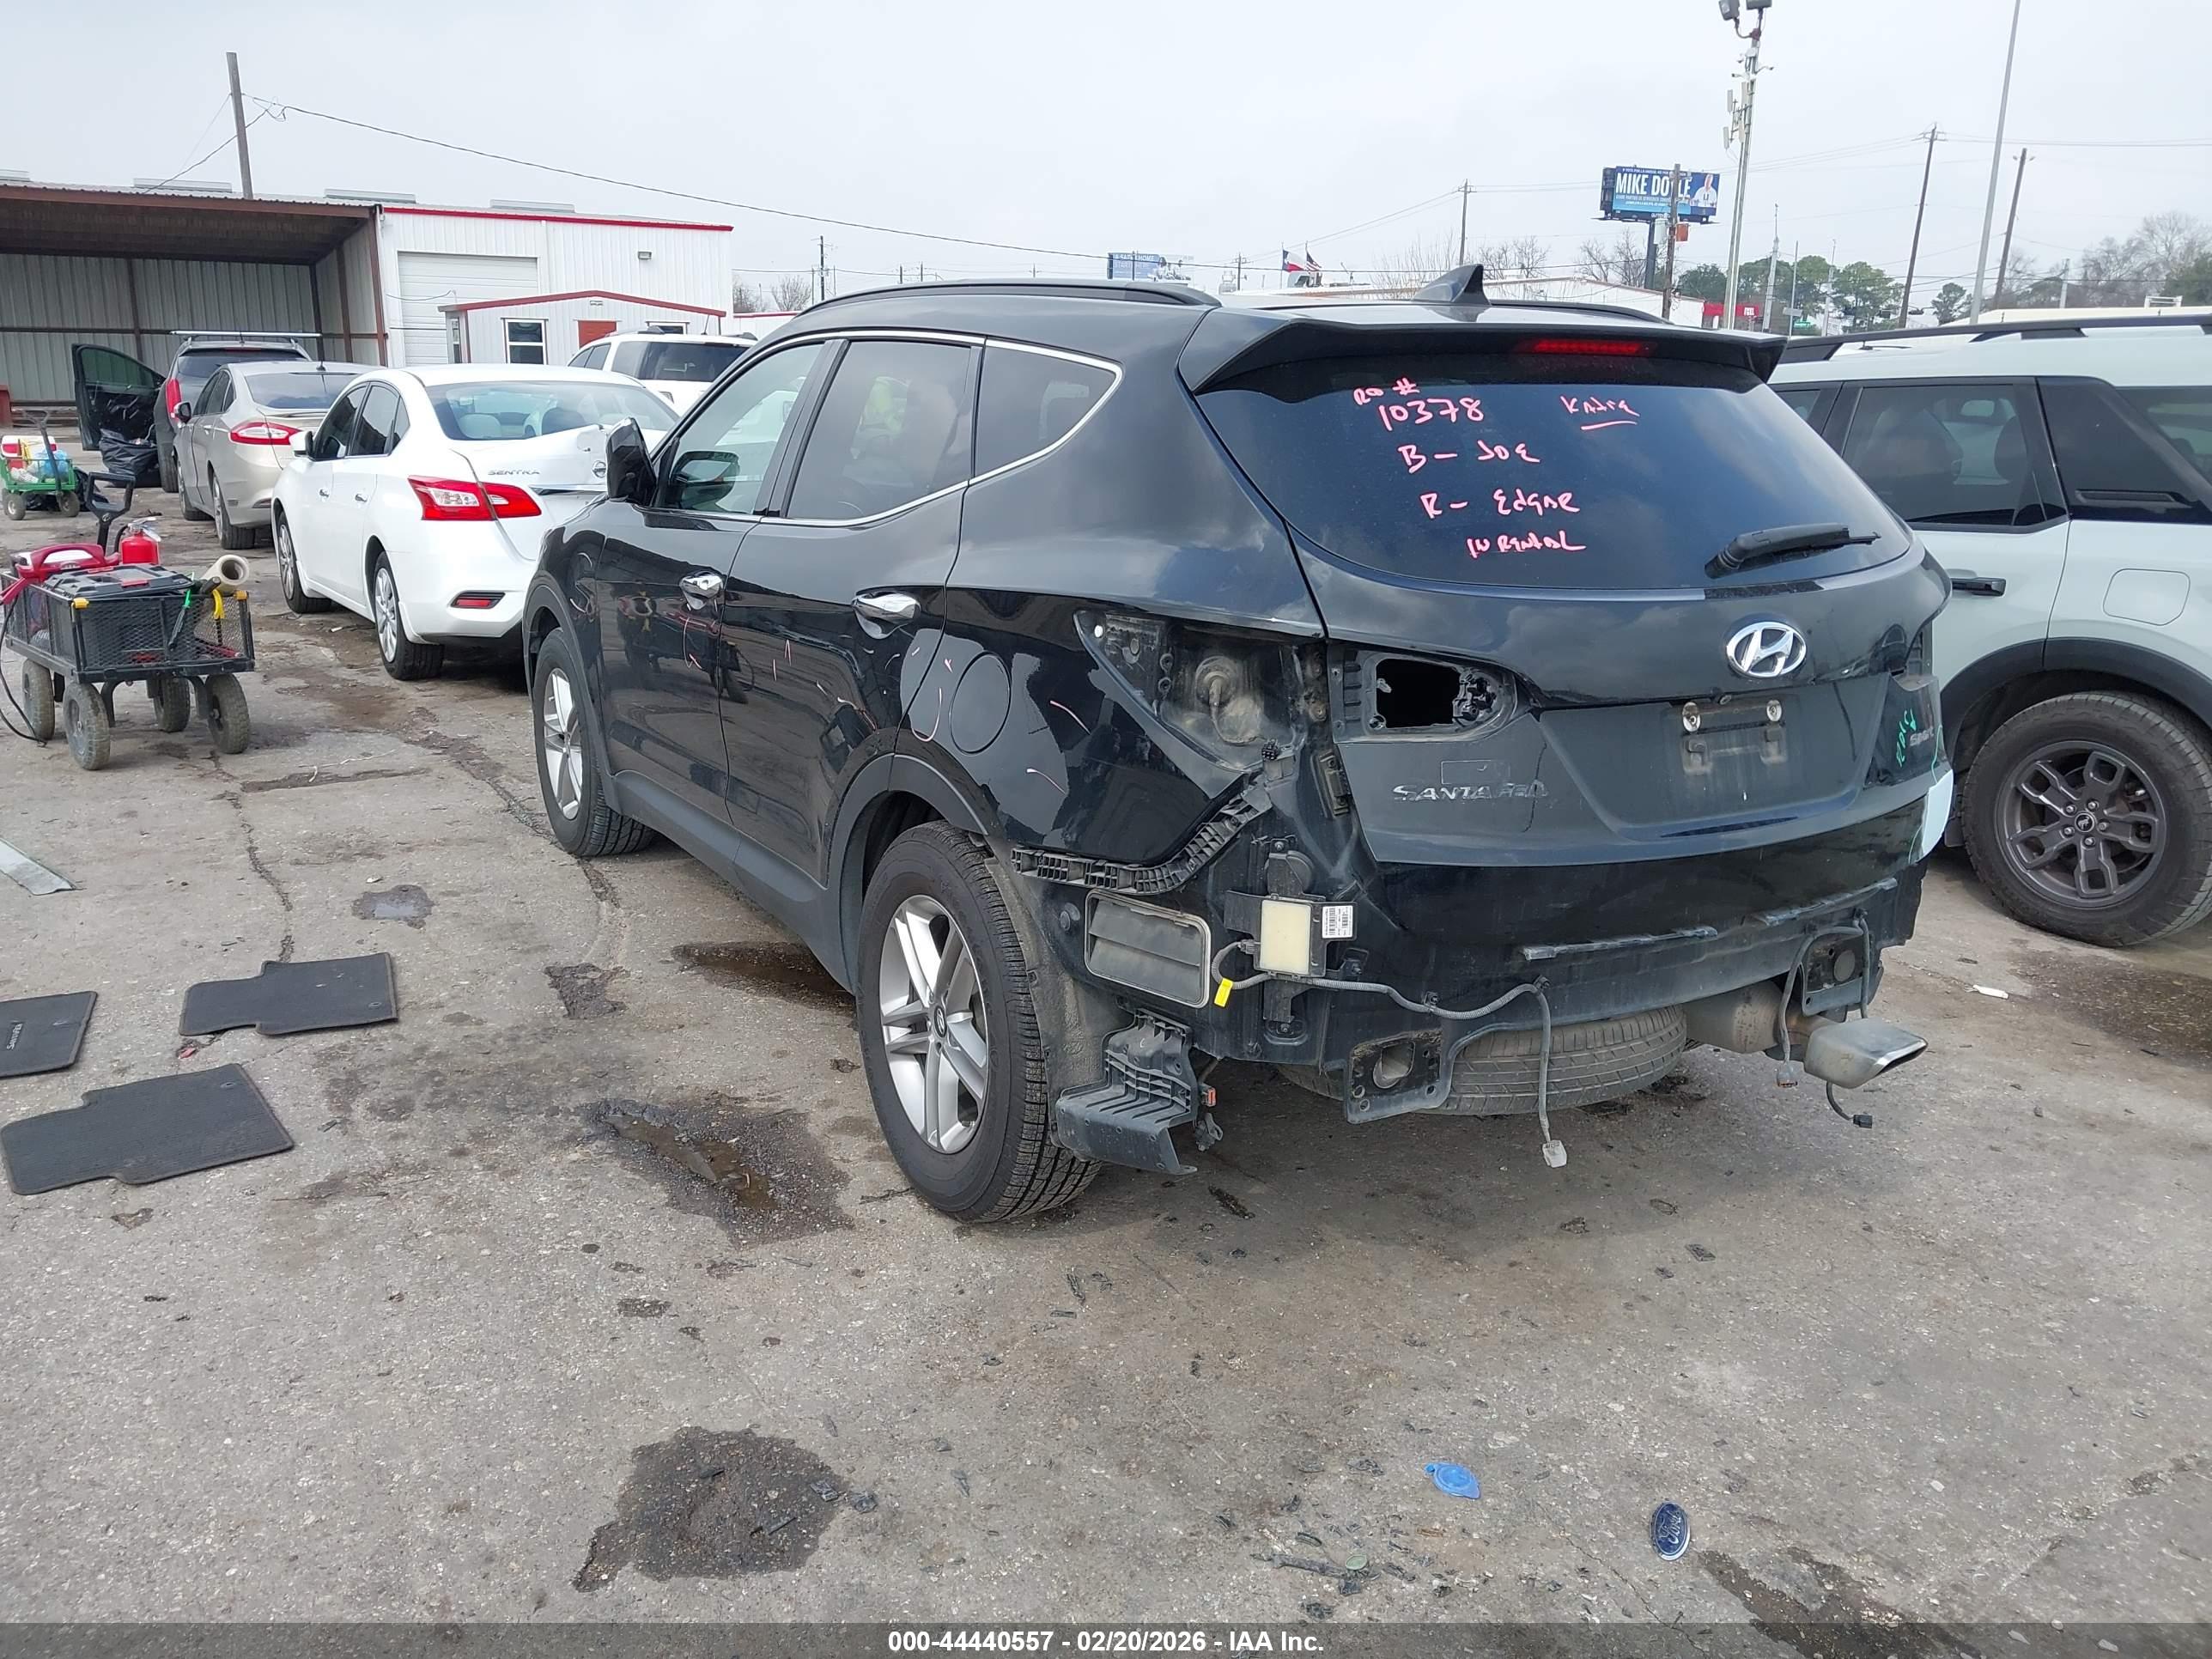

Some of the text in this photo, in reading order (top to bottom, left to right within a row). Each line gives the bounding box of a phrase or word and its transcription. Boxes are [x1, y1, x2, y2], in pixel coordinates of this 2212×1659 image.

[1615, 172, 1650, 195] MIKE
[1392, 378, 1420, 396] #
[1378, 397, 1485, 431] 10378
[1393, 785, 1492, 801] SANTA
[1657, 1510, 1681, 1545] Ford
